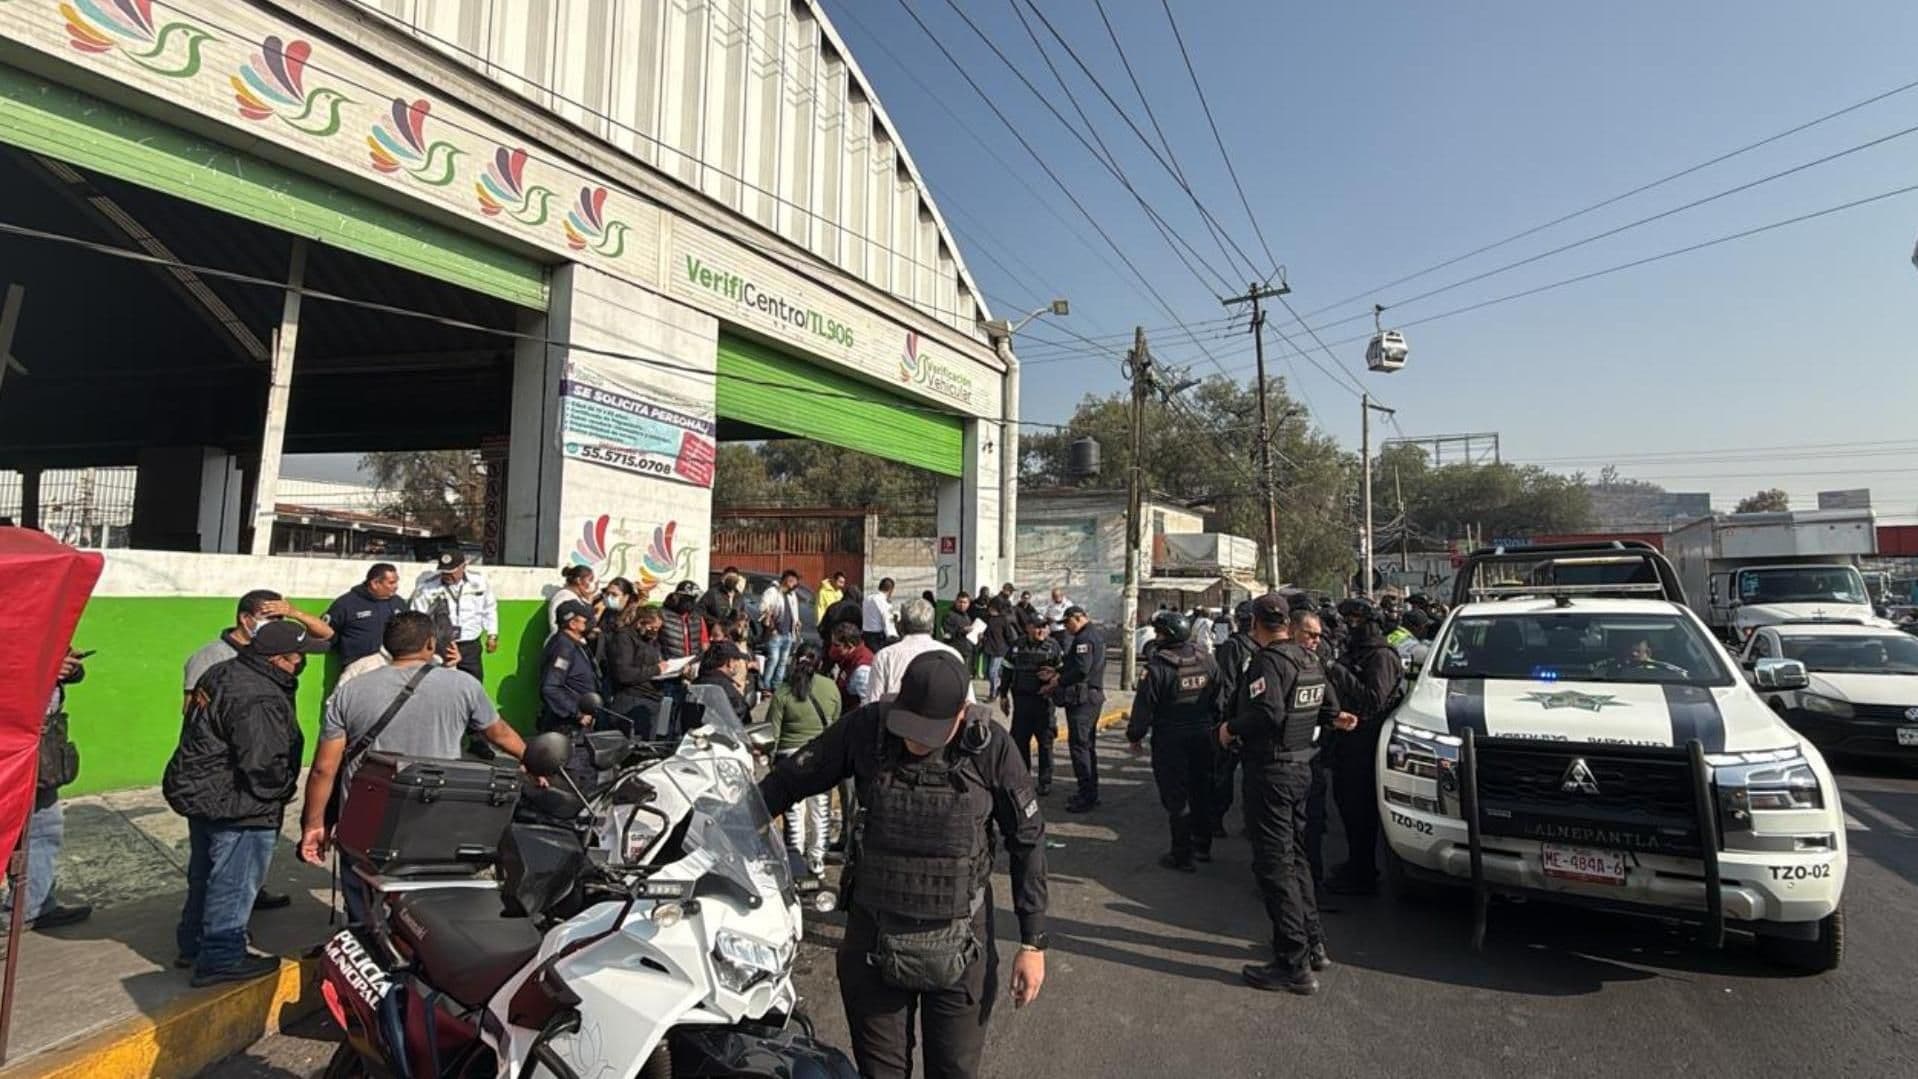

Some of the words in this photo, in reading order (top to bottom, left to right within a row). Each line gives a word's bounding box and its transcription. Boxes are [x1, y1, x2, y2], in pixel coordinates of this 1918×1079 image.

[574, 385, 593, 399] SE
[593, 390, 649, 416] SOLICITA
[581, 446, 672, 475] 55.5715.0708
[1390, 810, 1434, 836] TZO-02
[1768, 863, 1831, 880] TZO-02
[325, 940, 380, 1011] MUNICIPAL
